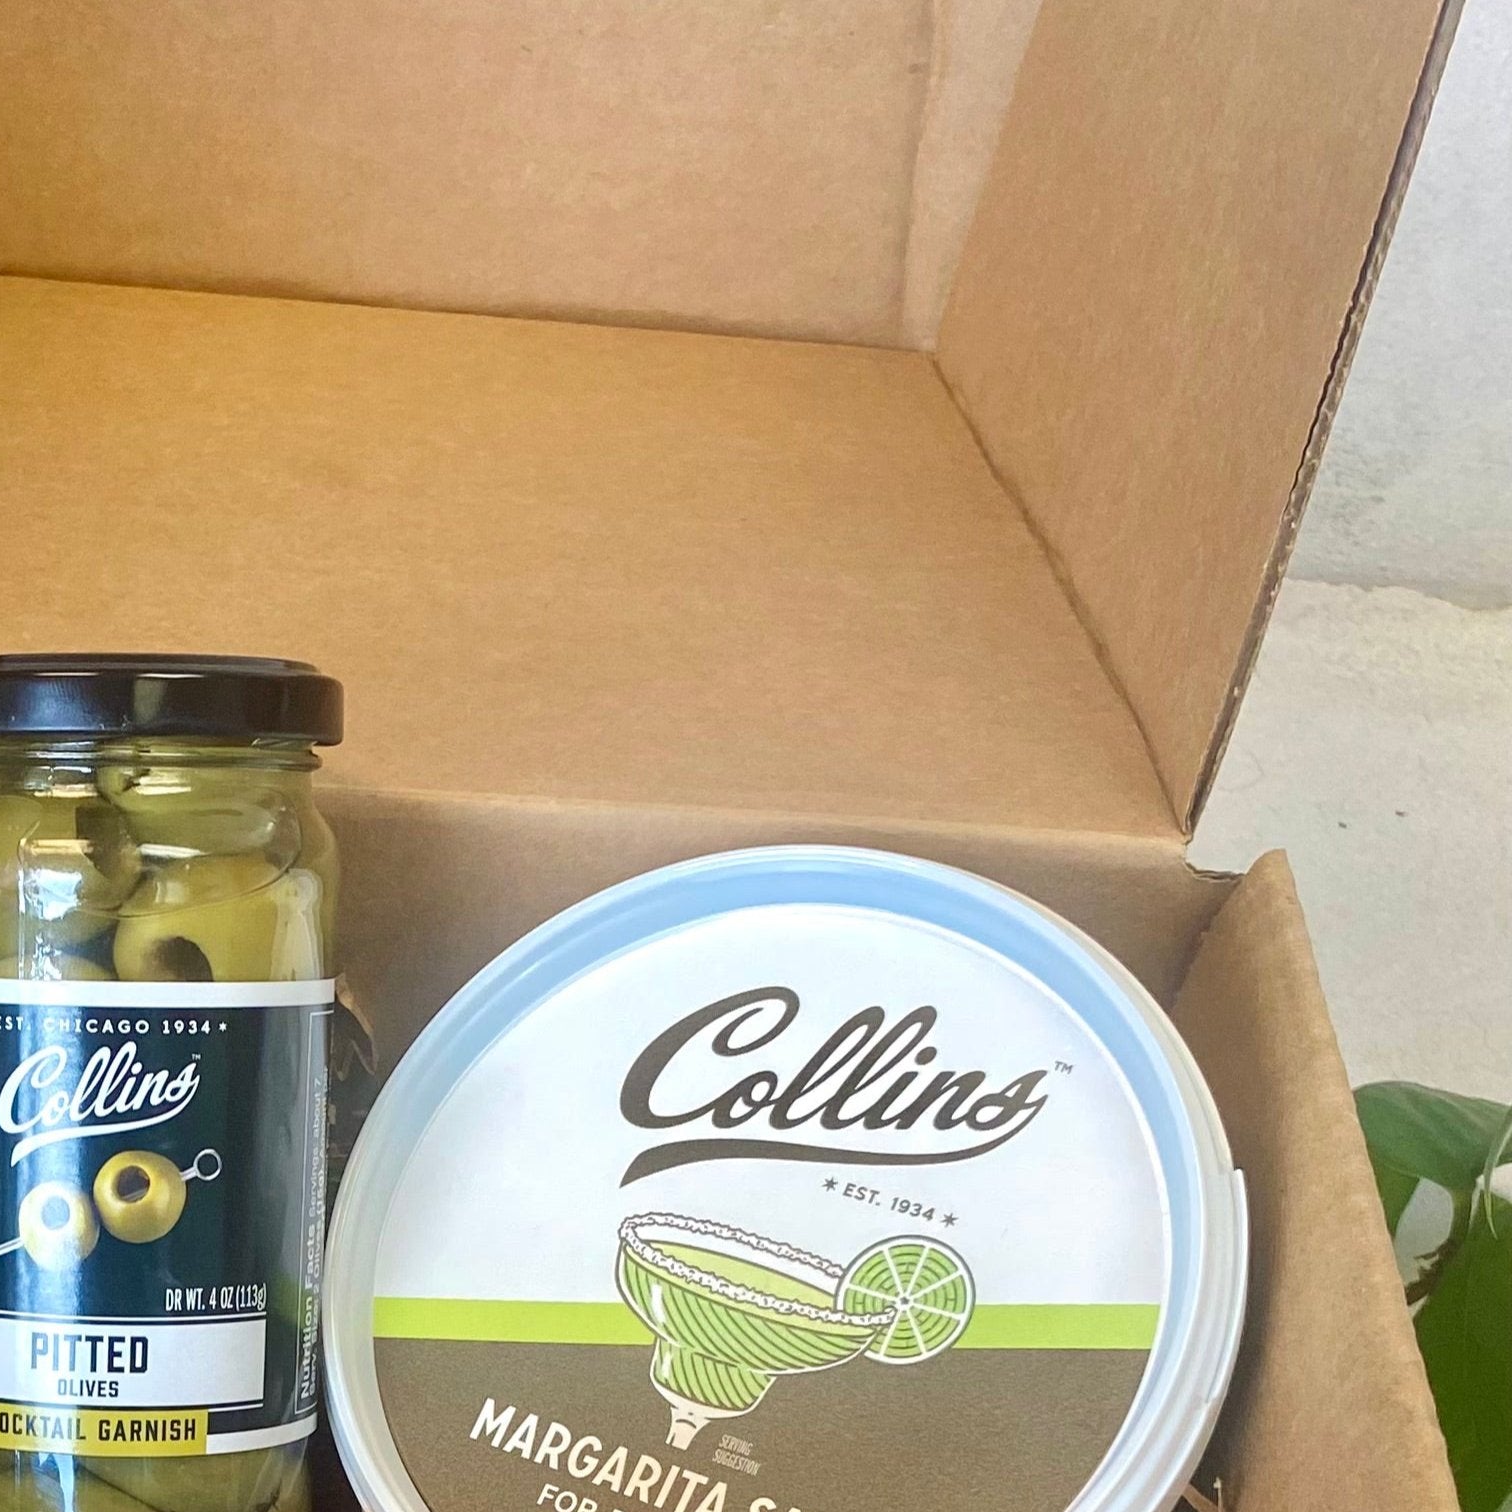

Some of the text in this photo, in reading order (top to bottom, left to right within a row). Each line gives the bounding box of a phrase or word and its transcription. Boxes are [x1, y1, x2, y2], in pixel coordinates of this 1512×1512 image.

[44, 1017, 150, 1034] CHICAGO
[161, 1019, 212, 1034] 1934
[619, 986, 1050, 1187] Collins
[841, 1182, 935, 1221] EST. 1934
[305, 1223, 316, 1290] Facts
[165, 1283, 267, 1312] DR WT. 4 OZ (113g)
[30, 1331, 149, 1375] PITTED
[300, 1295, 313, 1400] Nutrition
[57, 1379, 119, 1399] OLIVES
[98, 1417, 197, 1442] GARNISH
